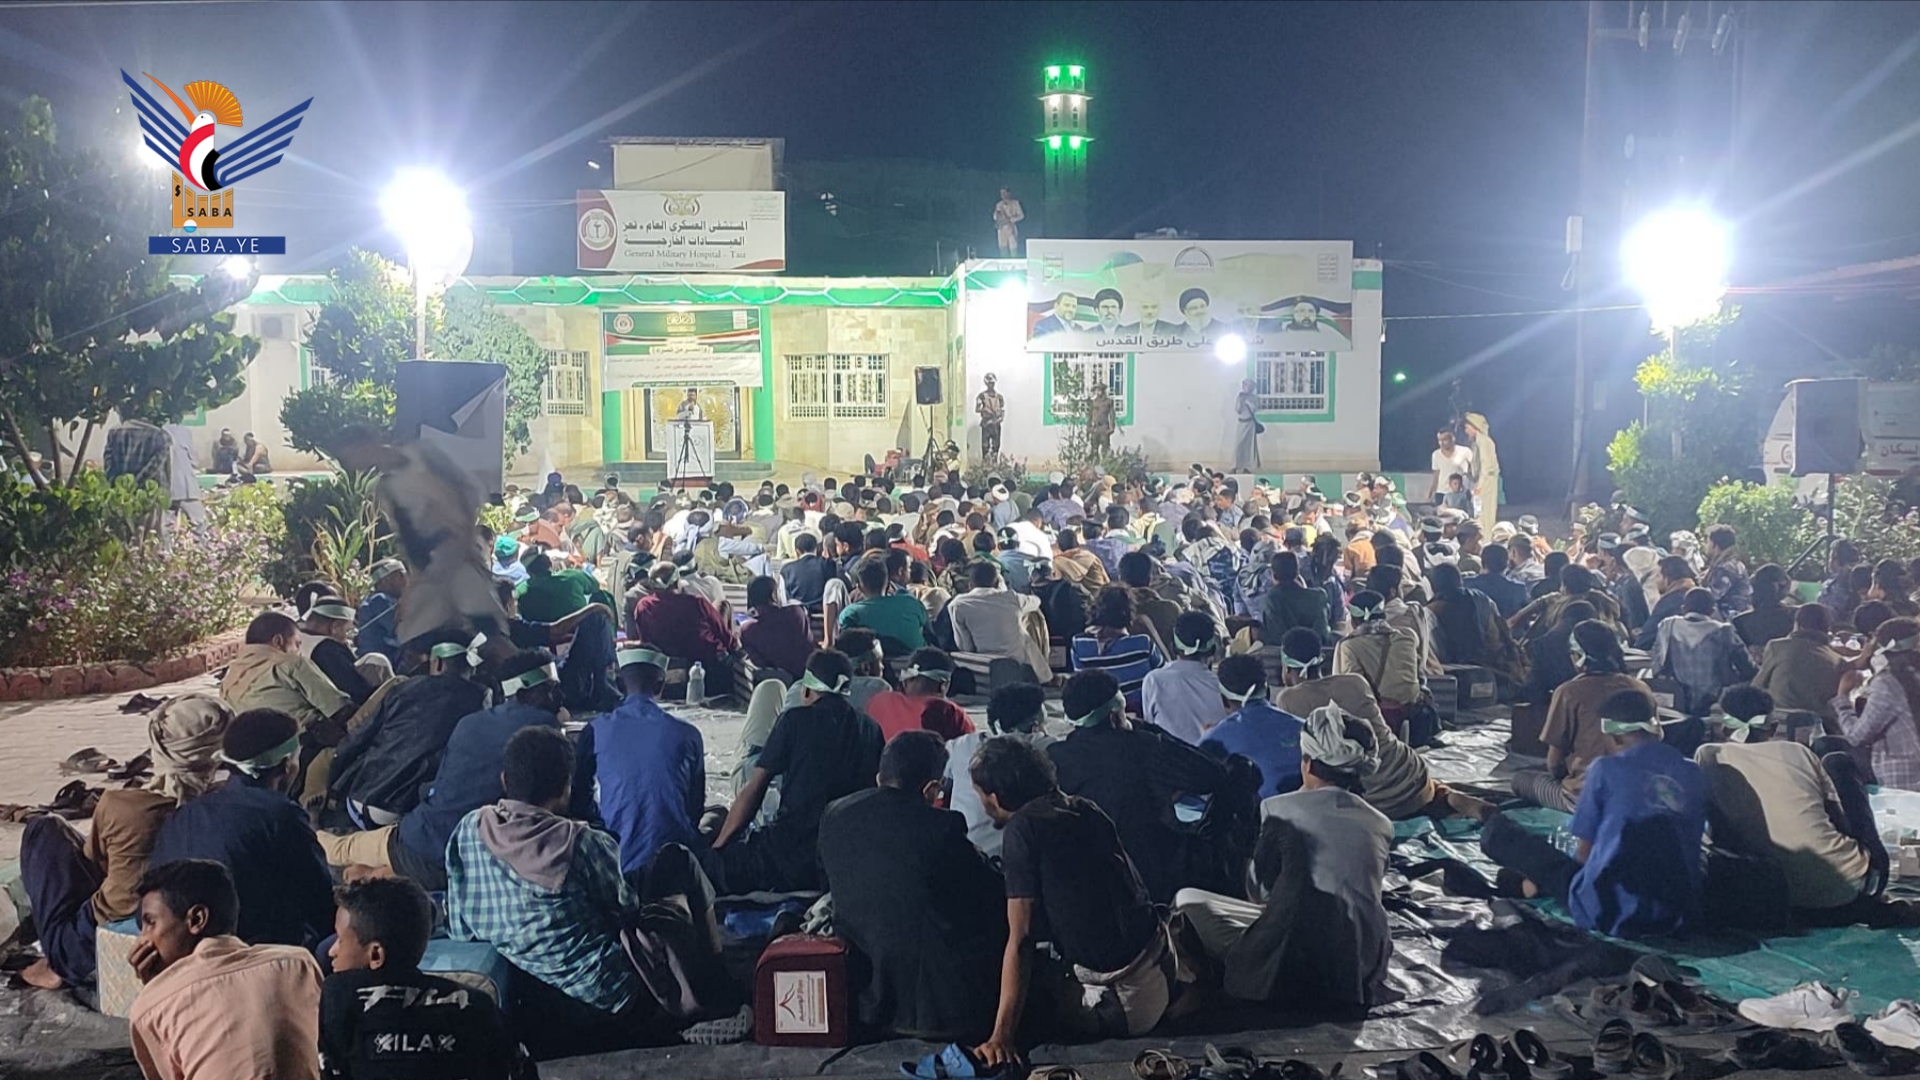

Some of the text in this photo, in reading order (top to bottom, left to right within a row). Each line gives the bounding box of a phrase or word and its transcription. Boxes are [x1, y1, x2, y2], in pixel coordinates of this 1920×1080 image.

[624, 249, 655, 258] General
[656, 249, 687, 259] Military
[689, 249, 721, 260] Hospital
[1096, 334, 1143, 347] القدس
[1146, 335, 1184, 348] طريق
